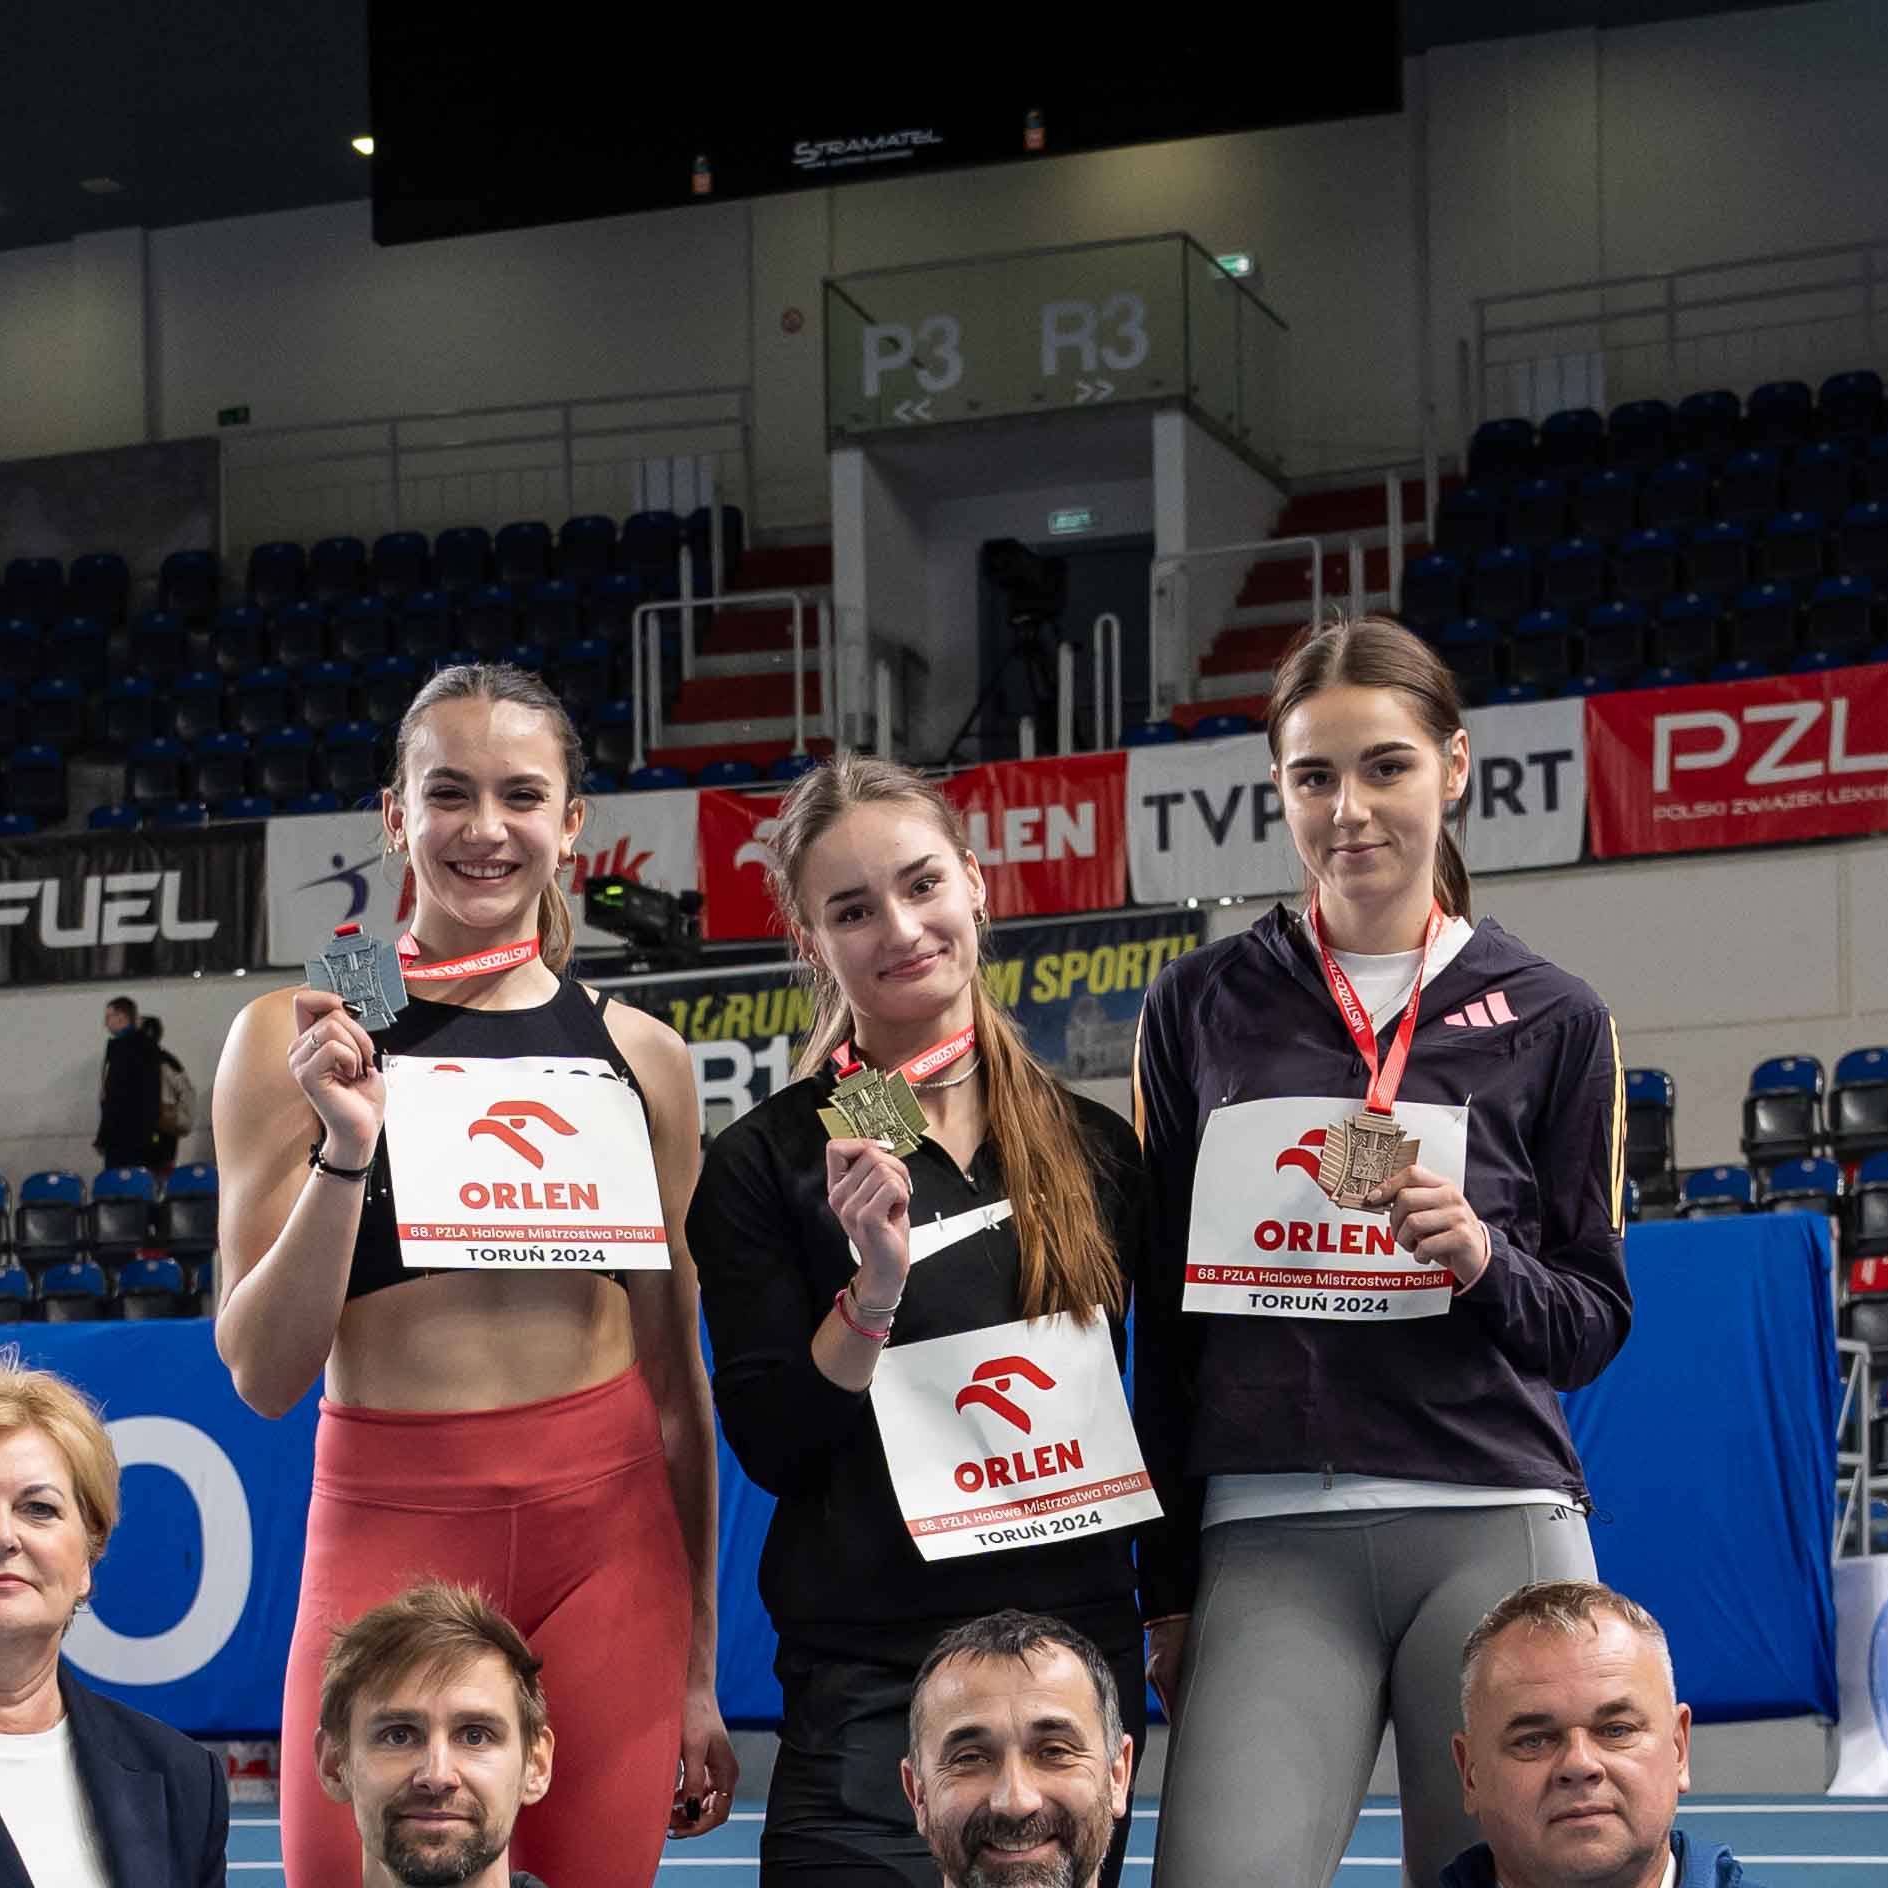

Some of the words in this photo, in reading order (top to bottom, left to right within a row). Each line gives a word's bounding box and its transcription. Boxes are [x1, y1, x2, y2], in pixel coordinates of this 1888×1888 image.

[789, 128, 943, 165] STRAMATEL
[863, 314, 963, 398] P3
[1039, 293, 1149, 375] R3
[964, 801, 1097, 867] LEN
[459, 1182, 600, 1210] ORLEN
[410, 1226, 432, 1238] 68.
[436, 1228, 468, 1238] PZLA
[472, 1228, 524, 1240] Halowe
[528, 1229, 611, 1240] Mistrzostwa
[615, 1229, 656, 1240] Polski
[1253, 1220, 1395, 1255] ORLEN
[466, 1246, 544, 1262] TORUŃ
[551, 1249, 606, 1262] 2024
[1197, 1268, 1219, 1280] 68.
[1223, 1270, 1254, 1282] PZLA
[1259, 1271, 1312, 1284] Halowe
[1316, 1273, 1401, 1287] Mistrzostwa
[1404, 1272, 1444, 1287] Polski
[1248, 1292, 1325, 1312] TORUŃ
[1333, 1297, 1388, 1312] 2024
[954, 1439, 1084, 1493] ORLEN
[918, 1519, 939, 1532] 68.
[941, 1513, 971, 1529] PZLA
[974, 1505, 1022, 1523] Halowe
[1024, 1488, 1101, 1514] Mistrzostwa
[1103, 1477, 1142, 1496] Polski
[975, 1521, 1047, 1546] TORUŃ
[1053, 1510, 1103, 1532] 2024
